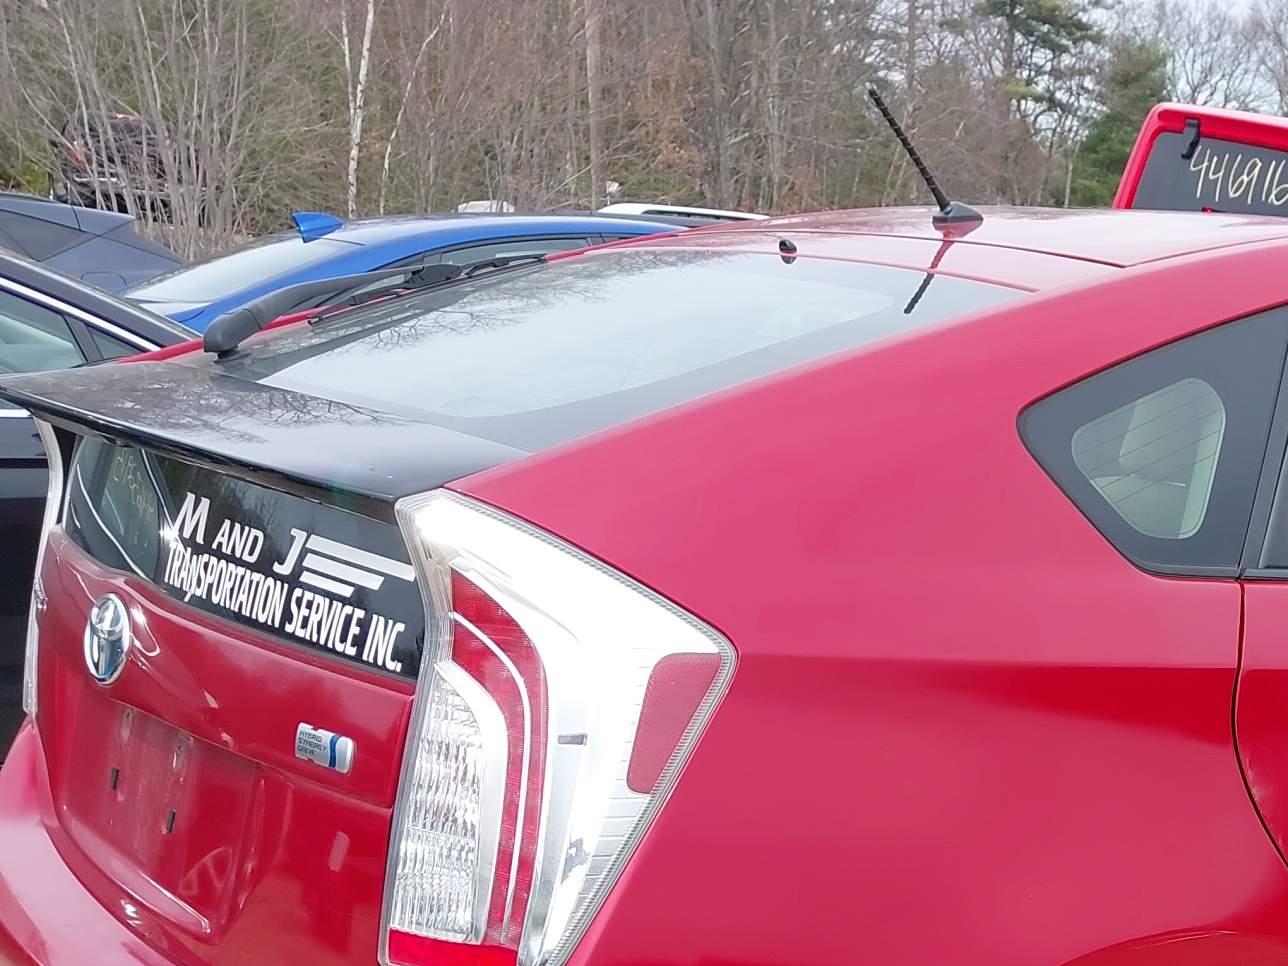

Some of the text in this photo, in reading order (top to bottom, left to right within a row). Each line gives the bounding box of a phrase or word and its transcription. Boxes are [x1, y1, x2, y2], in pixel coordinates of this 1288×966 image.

[174, 491, 211, 545] M
[212, 518, 265, 561] AND
[164, 542, 406, 672] TRANSPORTATION SERVICE INC.
